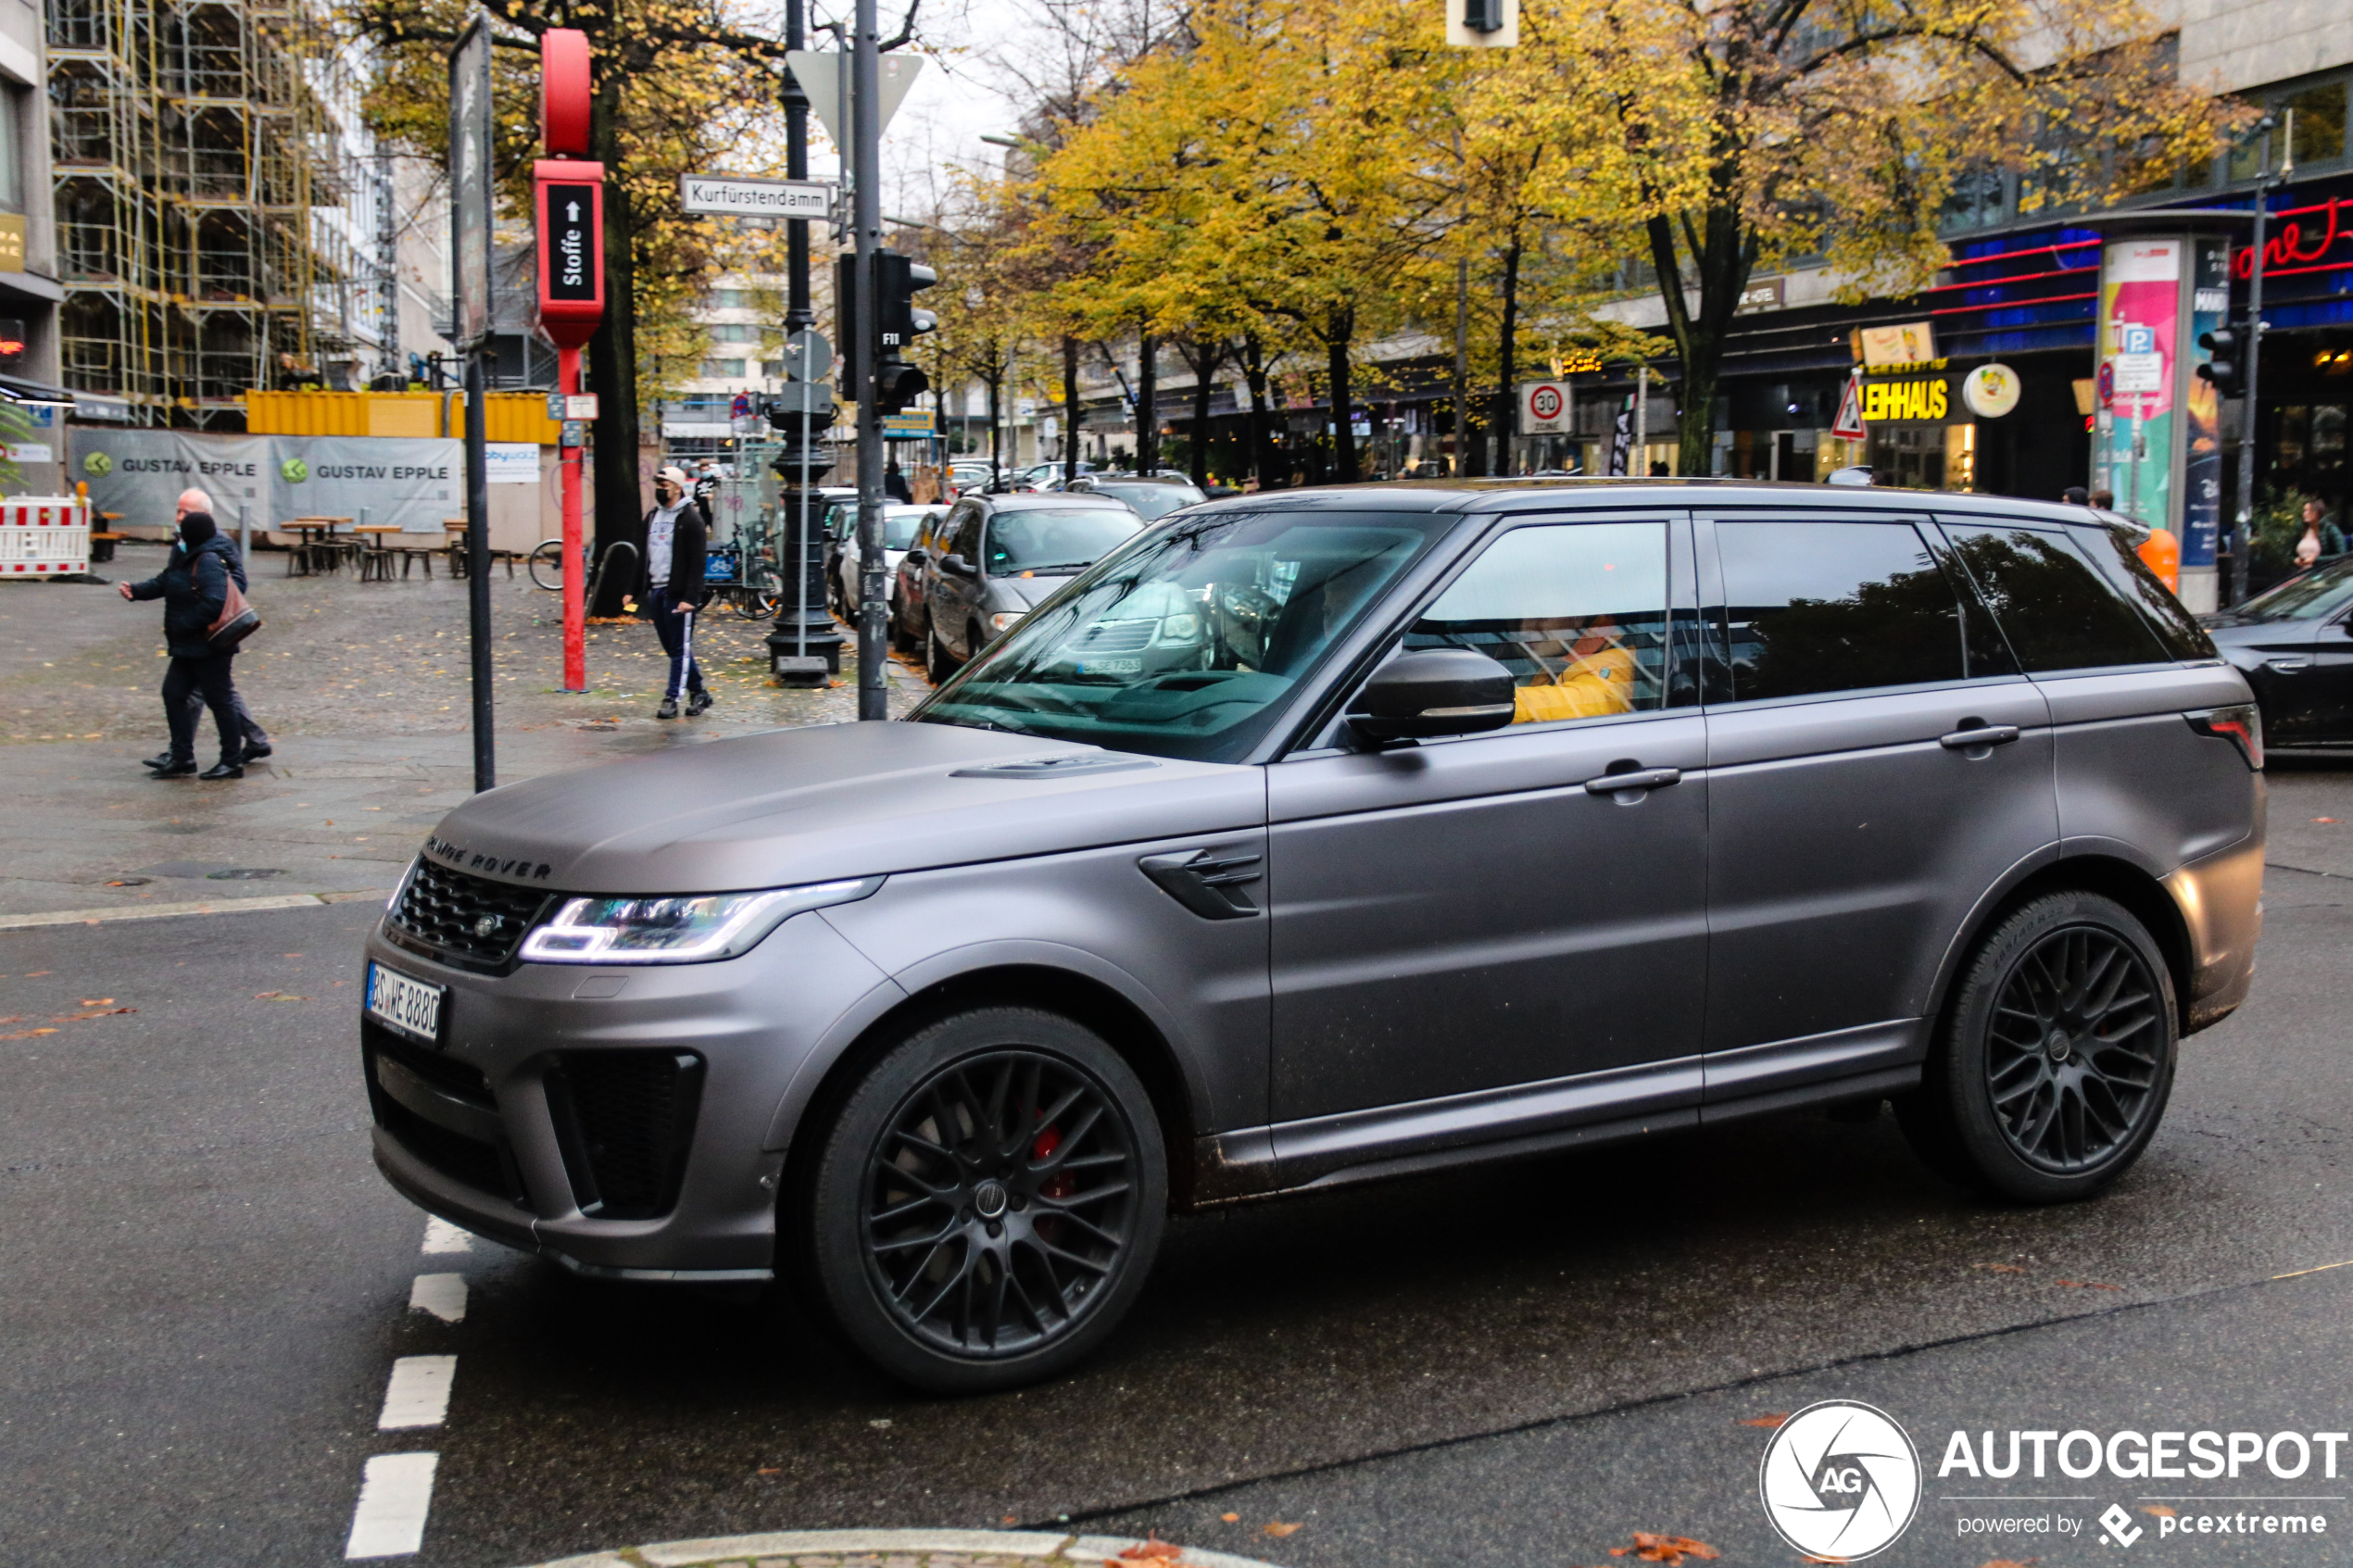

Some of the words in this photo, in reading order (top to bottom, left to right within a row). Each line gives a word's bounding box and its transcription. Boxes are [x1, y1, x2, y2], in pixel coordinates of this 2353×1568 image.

[692, 184, 824, 207] Kurfürstendamm
[560, 229, 583, 285] Stoffe
[883, 332, 900, 345] F11
[1536, 395, 1556, 411] 30
[1534, 421, 1559, 432] ZONE
[122, 458, 191, 473] GUSTAV
[199, 461, 257, 477] EPPLE
[318, 466, 386, 480] GUSTAV
[393, 467, 448, 480] EPPLE
[471, 854, 552, 880] ROVER
[373, 969, 386, 1010] BS
